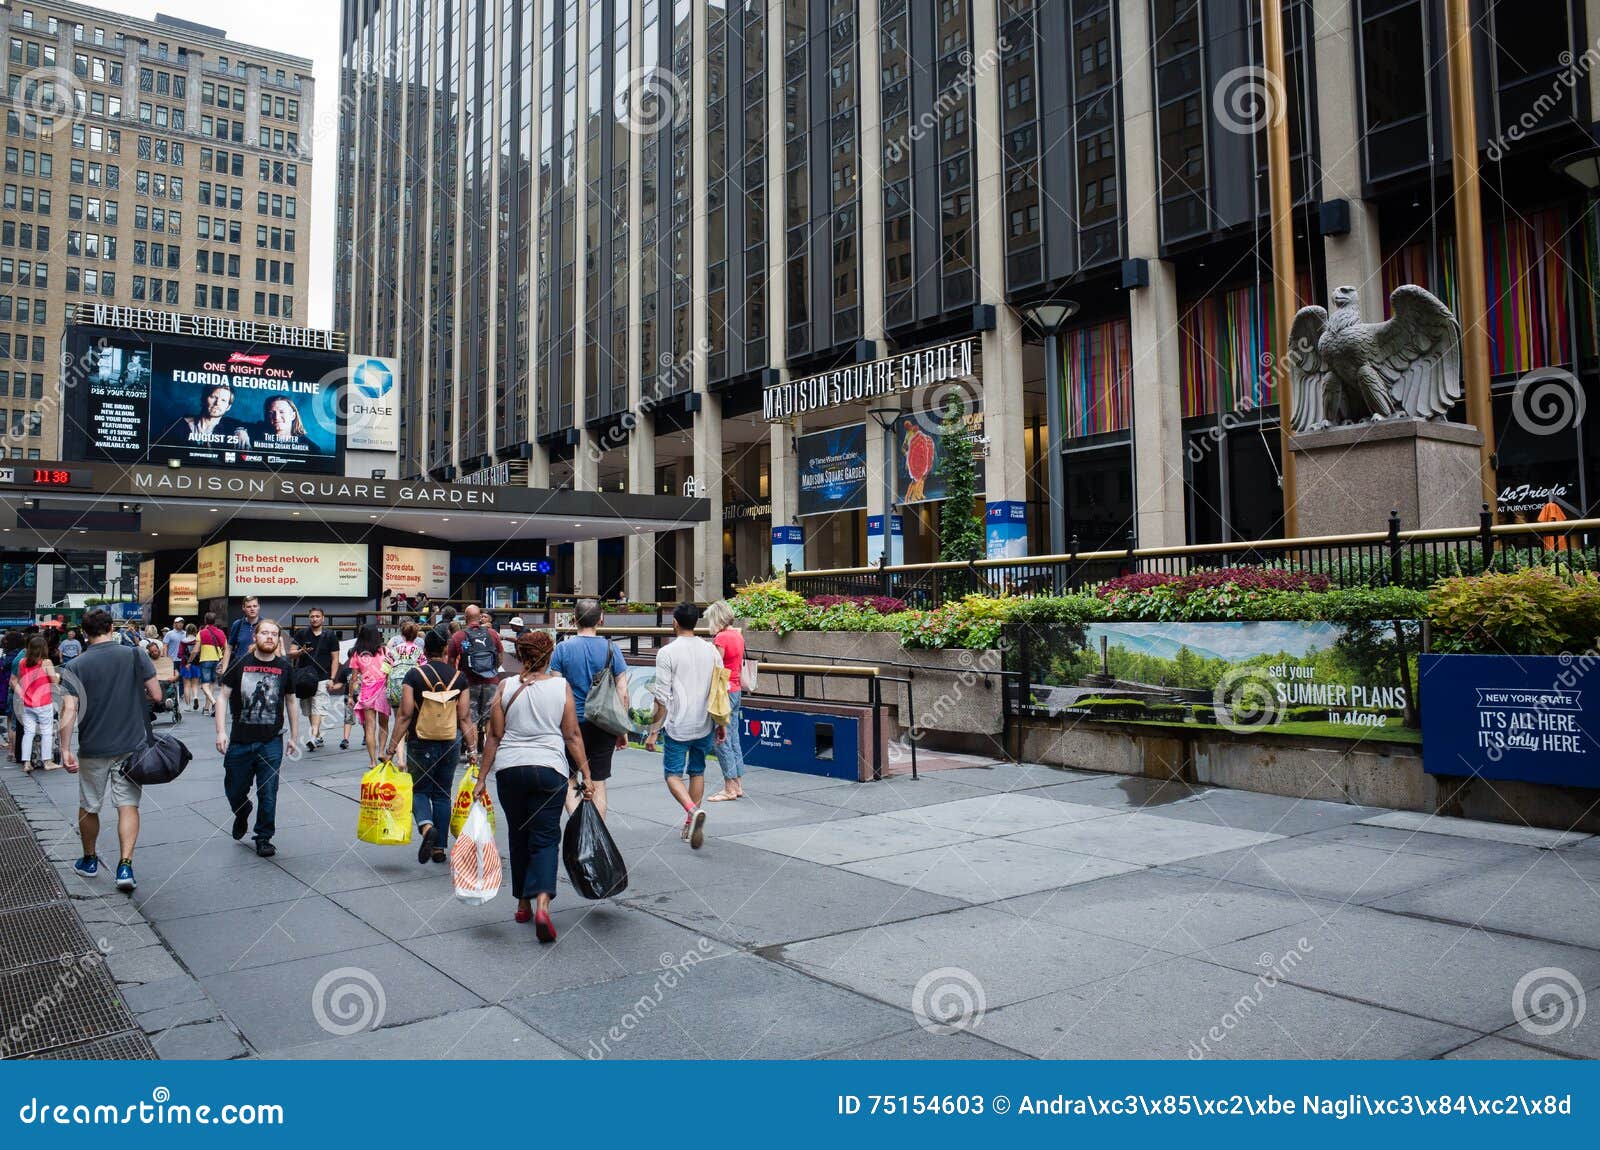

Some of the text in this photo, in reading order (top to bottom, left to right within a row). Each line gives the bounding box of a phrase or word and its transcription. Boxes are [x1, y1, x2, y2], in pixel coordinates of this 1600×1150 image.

[93, 303, 333, 351] MADISON SQUARE GARDEN
[203, 362, 294, 379] ONE NIGHT ONLY
[173, 370, 320, 395] FLORIDA GEORGIA LINE
[763, 341, 972, 419] MADISON SQUARE GARDEN
[107, 389, 124, 397] YOUR
[353, 405, 392, 416] CHASE
[102, 422, 133, 430] FEATURING
[188, 432, 239, 444] AUGUST 25
[815, 457, 826, 465] Time
[826, 455, 842, 463] Warner
[802, 473, 825, 487] MADISON
[825, 469, 844, 484] SQUARE
[844, 466, 866, 480] GARDEN
[135, 472, 495, 504] MADISON SQUARE GARDEN
[1497, 483, 1567, 502] LaFrieda
[235, 553, 320, 564] The best network
[386, 553, 399, 561] 30%
[235, 563, 254, 574] just
[256, 565, 285, 573] made
[401, 563, 415, 571] data.
[496, 561, 537, 572] CHASE
[235, 574, 299, 585] the best app.
[386, 573, 406, 581] Stream
[243, 665, 283, 675] DEFTONES
[1269, 662, 1316, 680] set your
[1276, 682, 1407, 709] SUMMER PLANS
[1486, 694, 1573, 705] NEW YORK STATE
[1328, 709, 1388, 728] in stone
[1480, 711, 1581, 732] IT'S ALL HERE.
[760, 720, 782, 739] NY
[1478, 730, 1587, 753] IT'S only HERE.
